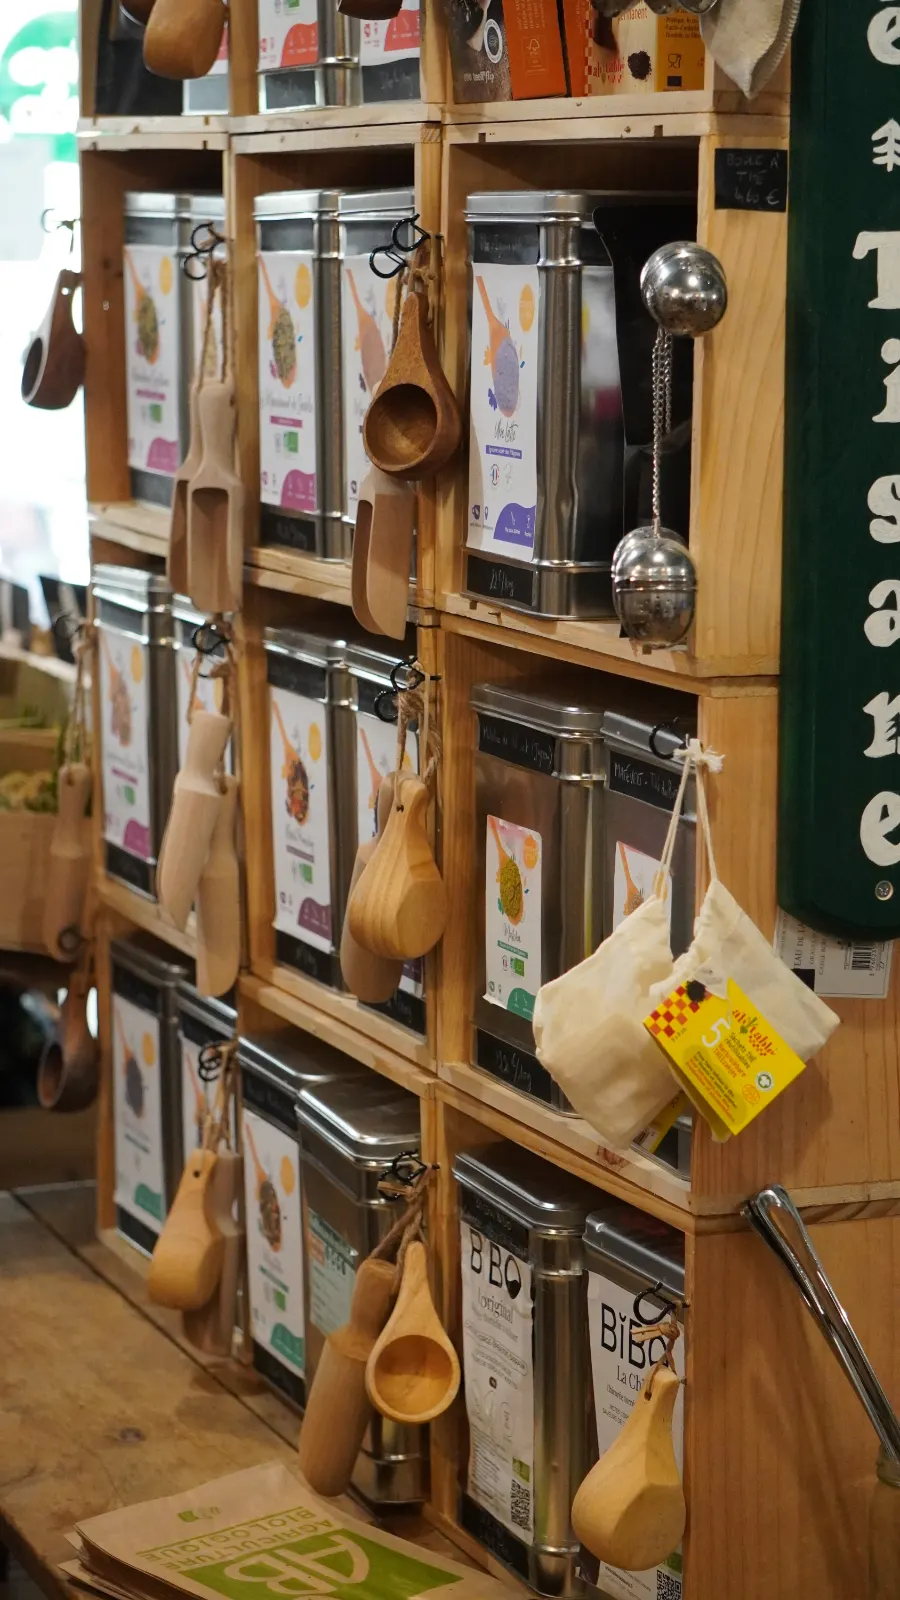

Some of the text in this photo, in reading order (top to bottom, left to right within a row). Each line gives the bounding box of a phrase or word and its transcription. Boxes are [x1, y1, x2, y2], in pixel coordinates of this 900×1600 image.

[853, 229, 900, 868] Tisane
[701, 1017, 731, 1048] 5
[144, 1509, 316, 1562] BIOLOGIQUE
[163, 1519, 335, 1573] AGRICULTURE
